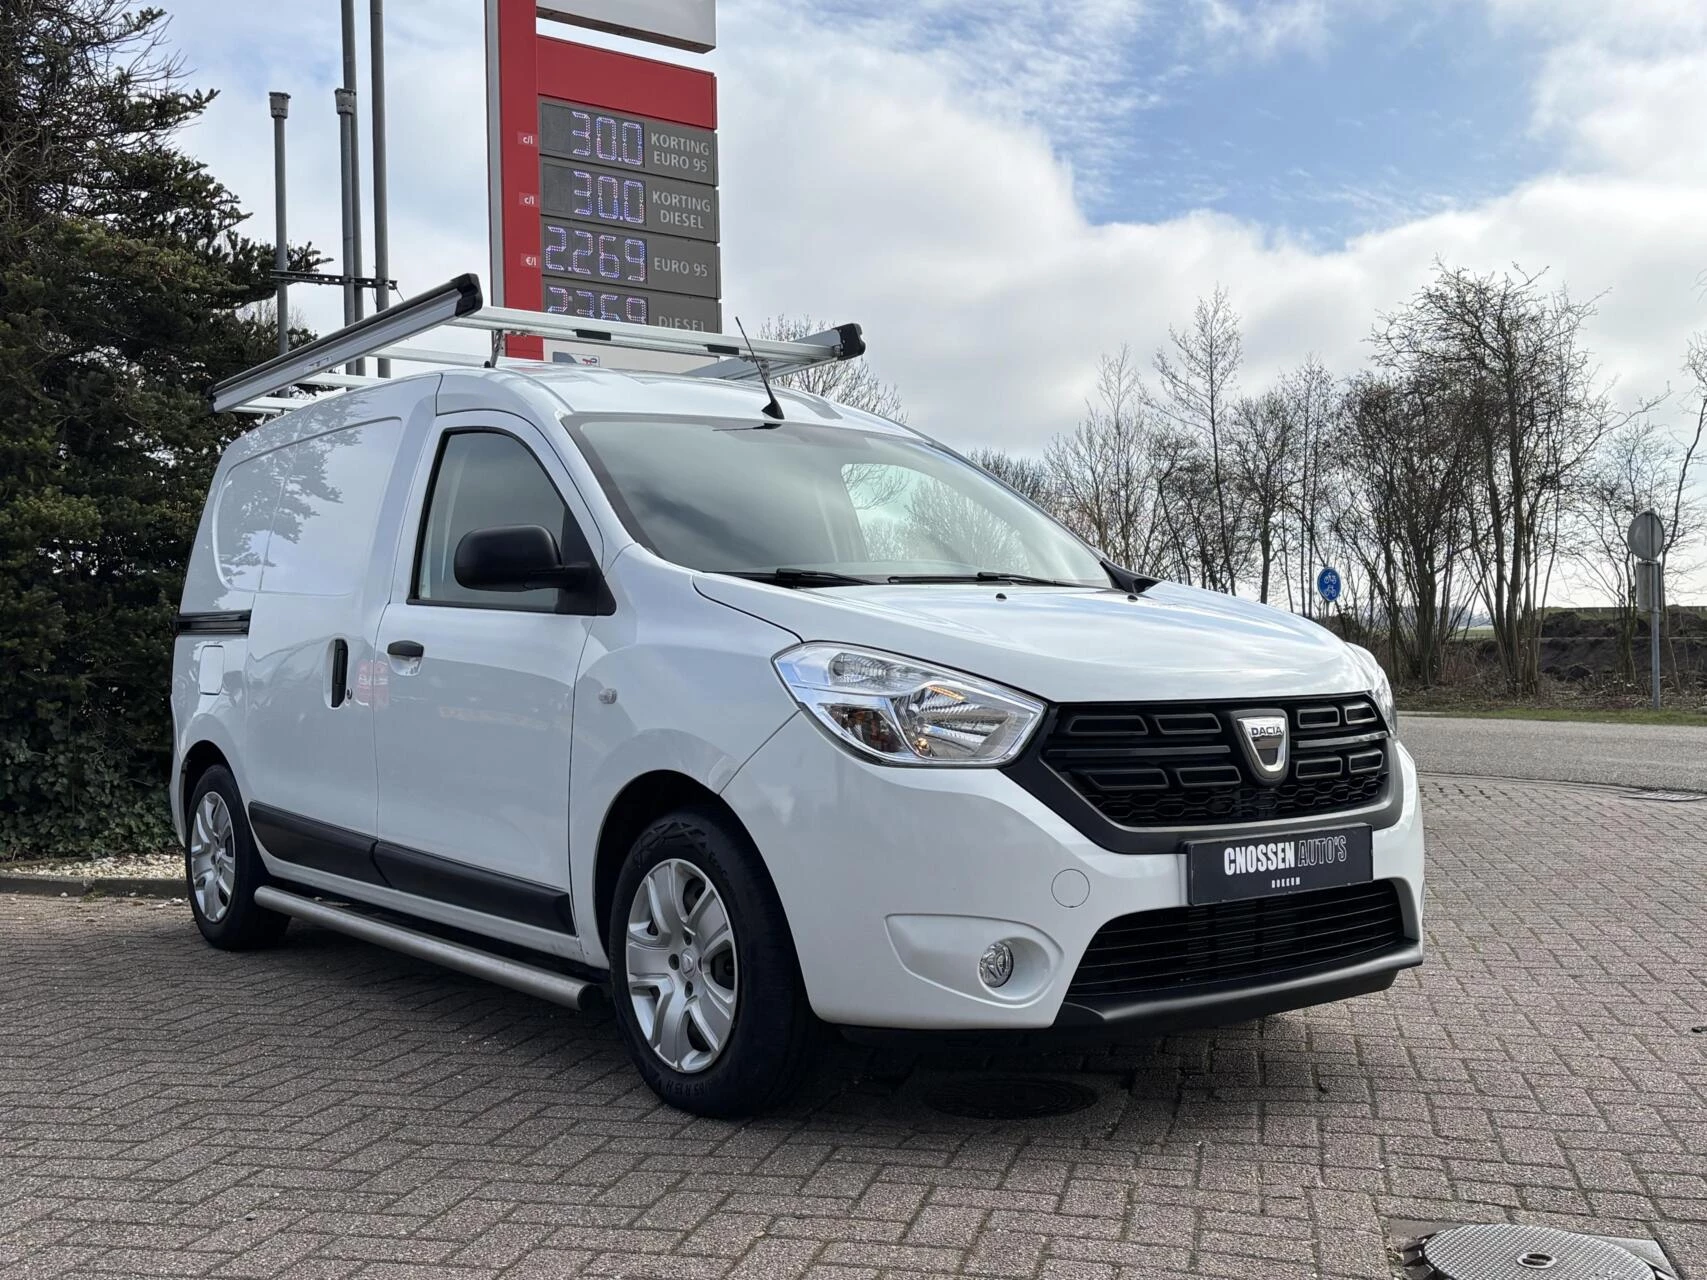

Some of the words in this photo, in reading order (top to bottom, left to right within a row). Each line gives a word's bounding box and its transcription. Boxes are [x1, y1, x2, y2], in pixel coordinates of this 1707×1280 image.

[571, 111, 644, 166] 30.0
[650, 132, 711, 156] KORTING
[653, 151, 690, 169] EURO
[693, 157, 708, 173] 95
[573, 170, 645, 224] 30.0
[652, 190, 711, 213] KORTING
[660, 210, 705, 229] DIESEL
[545, 226, 646, 282] 2.269
[653, 257, 689, 274] EURO
[693, 260, 709, 277] 95
[1250, 725, 1284, 737] DACIA
[1223, 841, 1296, 875] CNOSSEN
[1298, 835, 1348, 867] AUTO'S
